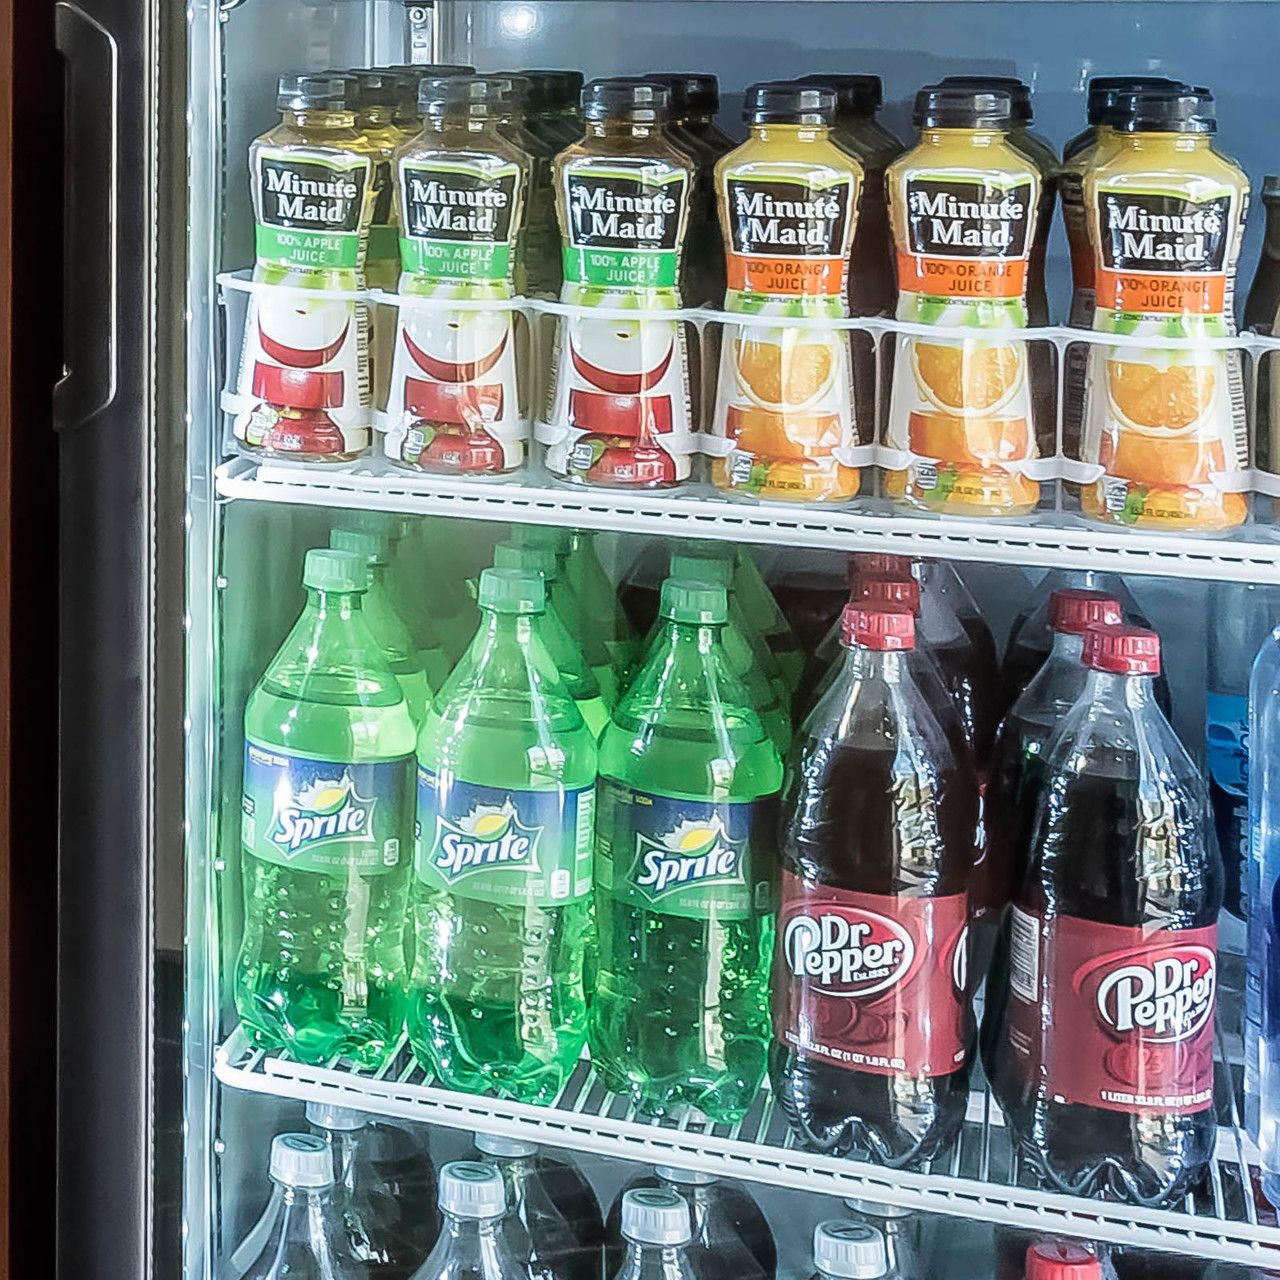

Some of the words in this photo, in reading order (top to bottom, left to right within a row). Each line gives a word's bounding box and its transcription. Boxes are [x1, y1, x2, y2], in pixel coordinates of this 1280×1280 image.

[266, 167, 357, 198] Minute
[410, 178, 507, 210] Minute
[276, 192, 343, 223] Maid
[579, 185, 676, 215] Minute
[738, 190, 840, 220] Minute
[916, 190, 1024, 221] Minute
[426, 205, 494, 232] Maid
[591, 212, 662, 241] Maid
[749, 218, 825, 247] Maid
[932, 218, 1011, 248] Maid
[1109, 203, 1220, 235] Minute
[288, 249, 326, 264] JUICE
[304, 236, 342, 252] APPLE
[454, 246, 492, 261] APPLE
[1124, 231, 1205, 262] Maid
[439, 260, 477, 274] JUICE
[606, 269, 646, 284] JUICE
[620, 254, 660, 270] APPLE
[272, 803, 368, 847] Sprite
[437, 833, 529, 875] Sprite
[640, 848, 736, 888] Sprite
[821, 915, 871, 951] Dr
[784, 915, 904, 985] Pepper
[1154, 958, 1199, 997] Dr
[1098, 966, 1214, 1033] Pepper
